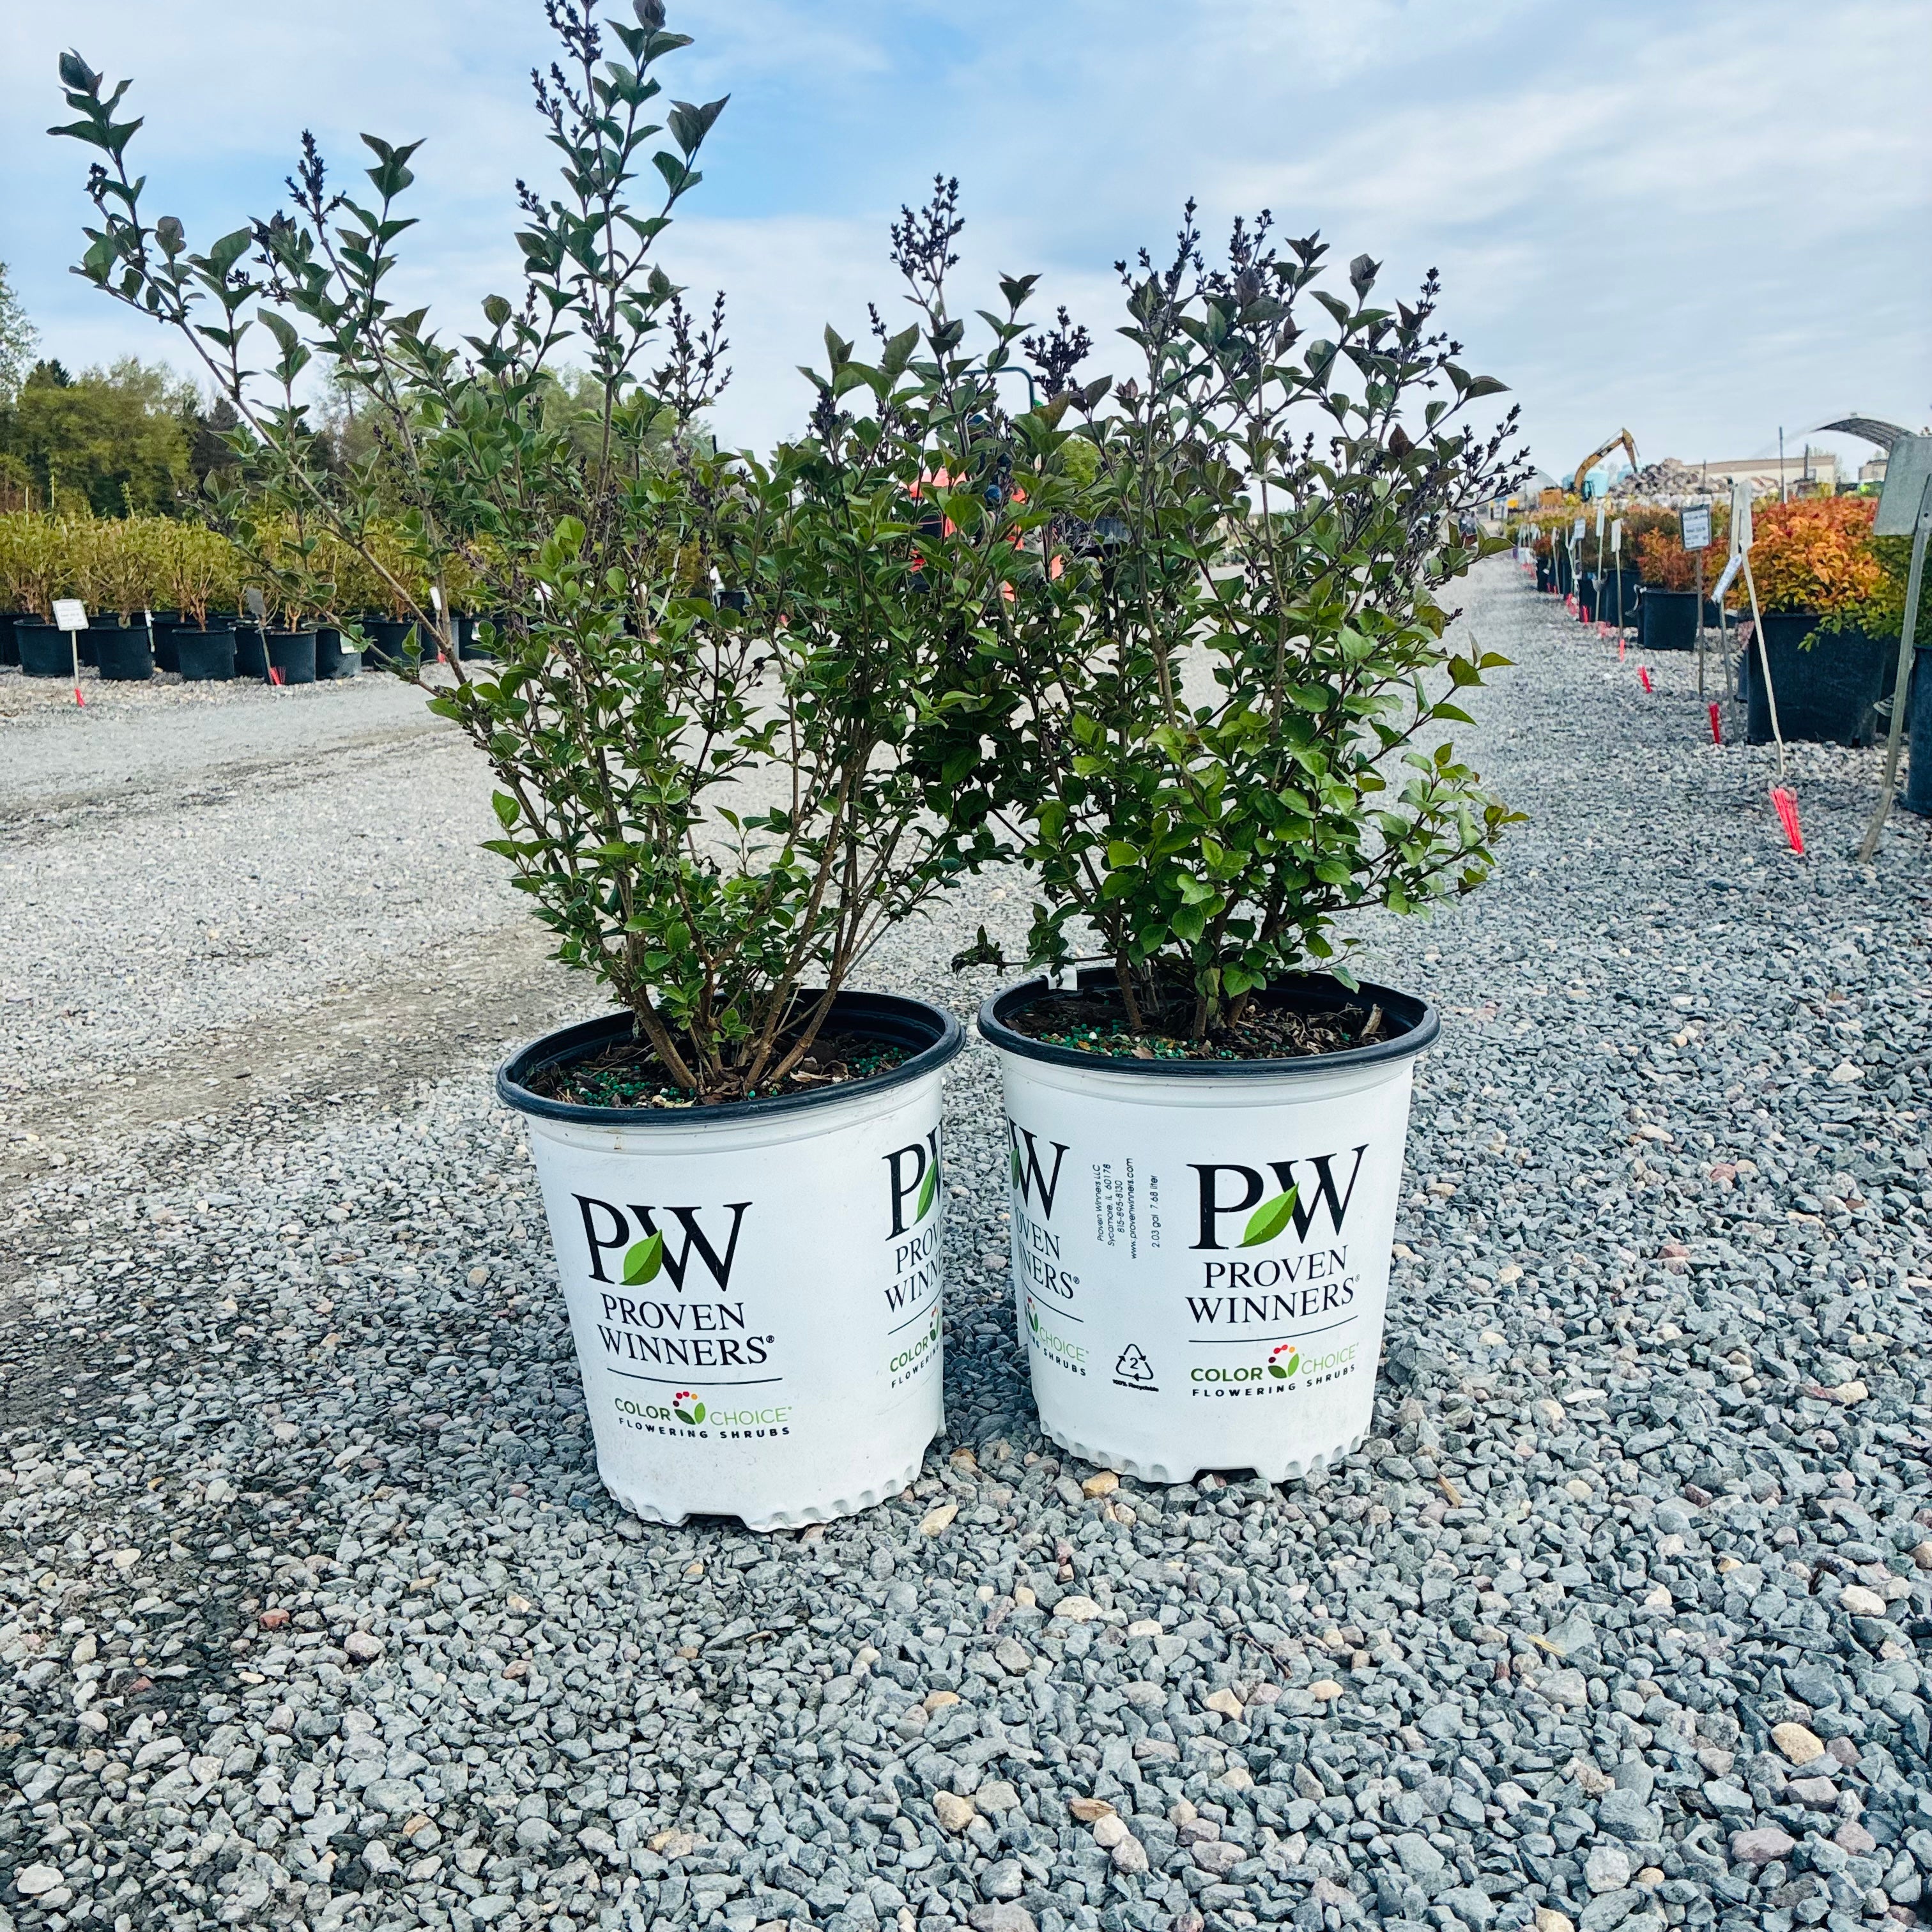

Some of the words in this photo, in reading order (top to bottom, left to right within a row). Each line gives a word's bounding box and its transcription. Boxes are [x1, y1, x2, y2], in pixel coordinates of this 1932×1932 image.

[1006, 1115, 1070, 1221] W
[1092, 1164, 1101, 1179] LLC
[1103, 1163, 1112, 1190] 60178
[1150, 1175, 1158, 1190] liter
[1114, 1180, 1125, 1233] 815-895-8130
[1126, 1158, 1138, 1259] www.provenwinners.com
[1150, 1192, 1159, 1209] 7.68
[1185, 1144, 1369, 1250] PW
[1014, 1198, 1061, 1261] OVEN
[1151, 1214, 1162, 1228] gal
[571, 1192, 753, 1292] PW
[1151, 1230, 1160, 1248] 2.03
[1203, 1244, 1348, 1289] PROVEN
[600, 1292, 745, 1331] PROVEN
[890, 1335, 928, 1372] COLOR
[1044, 1348, 1085, 1376] SHRUBS
[1130, 1357, 1139, 1369] 2
[1190, 1367, 1262, 1382] COLOR
[1192, 1382, 1296, 1397] FLOWERING
[1307, 1364, 1355, 1388] SHRUBS
[615, 1397, 671, 1421] COLOR
[619, 1417, 709, 1439] FLOWERING
[720, 1427, 790, 1439] SHRUBS
